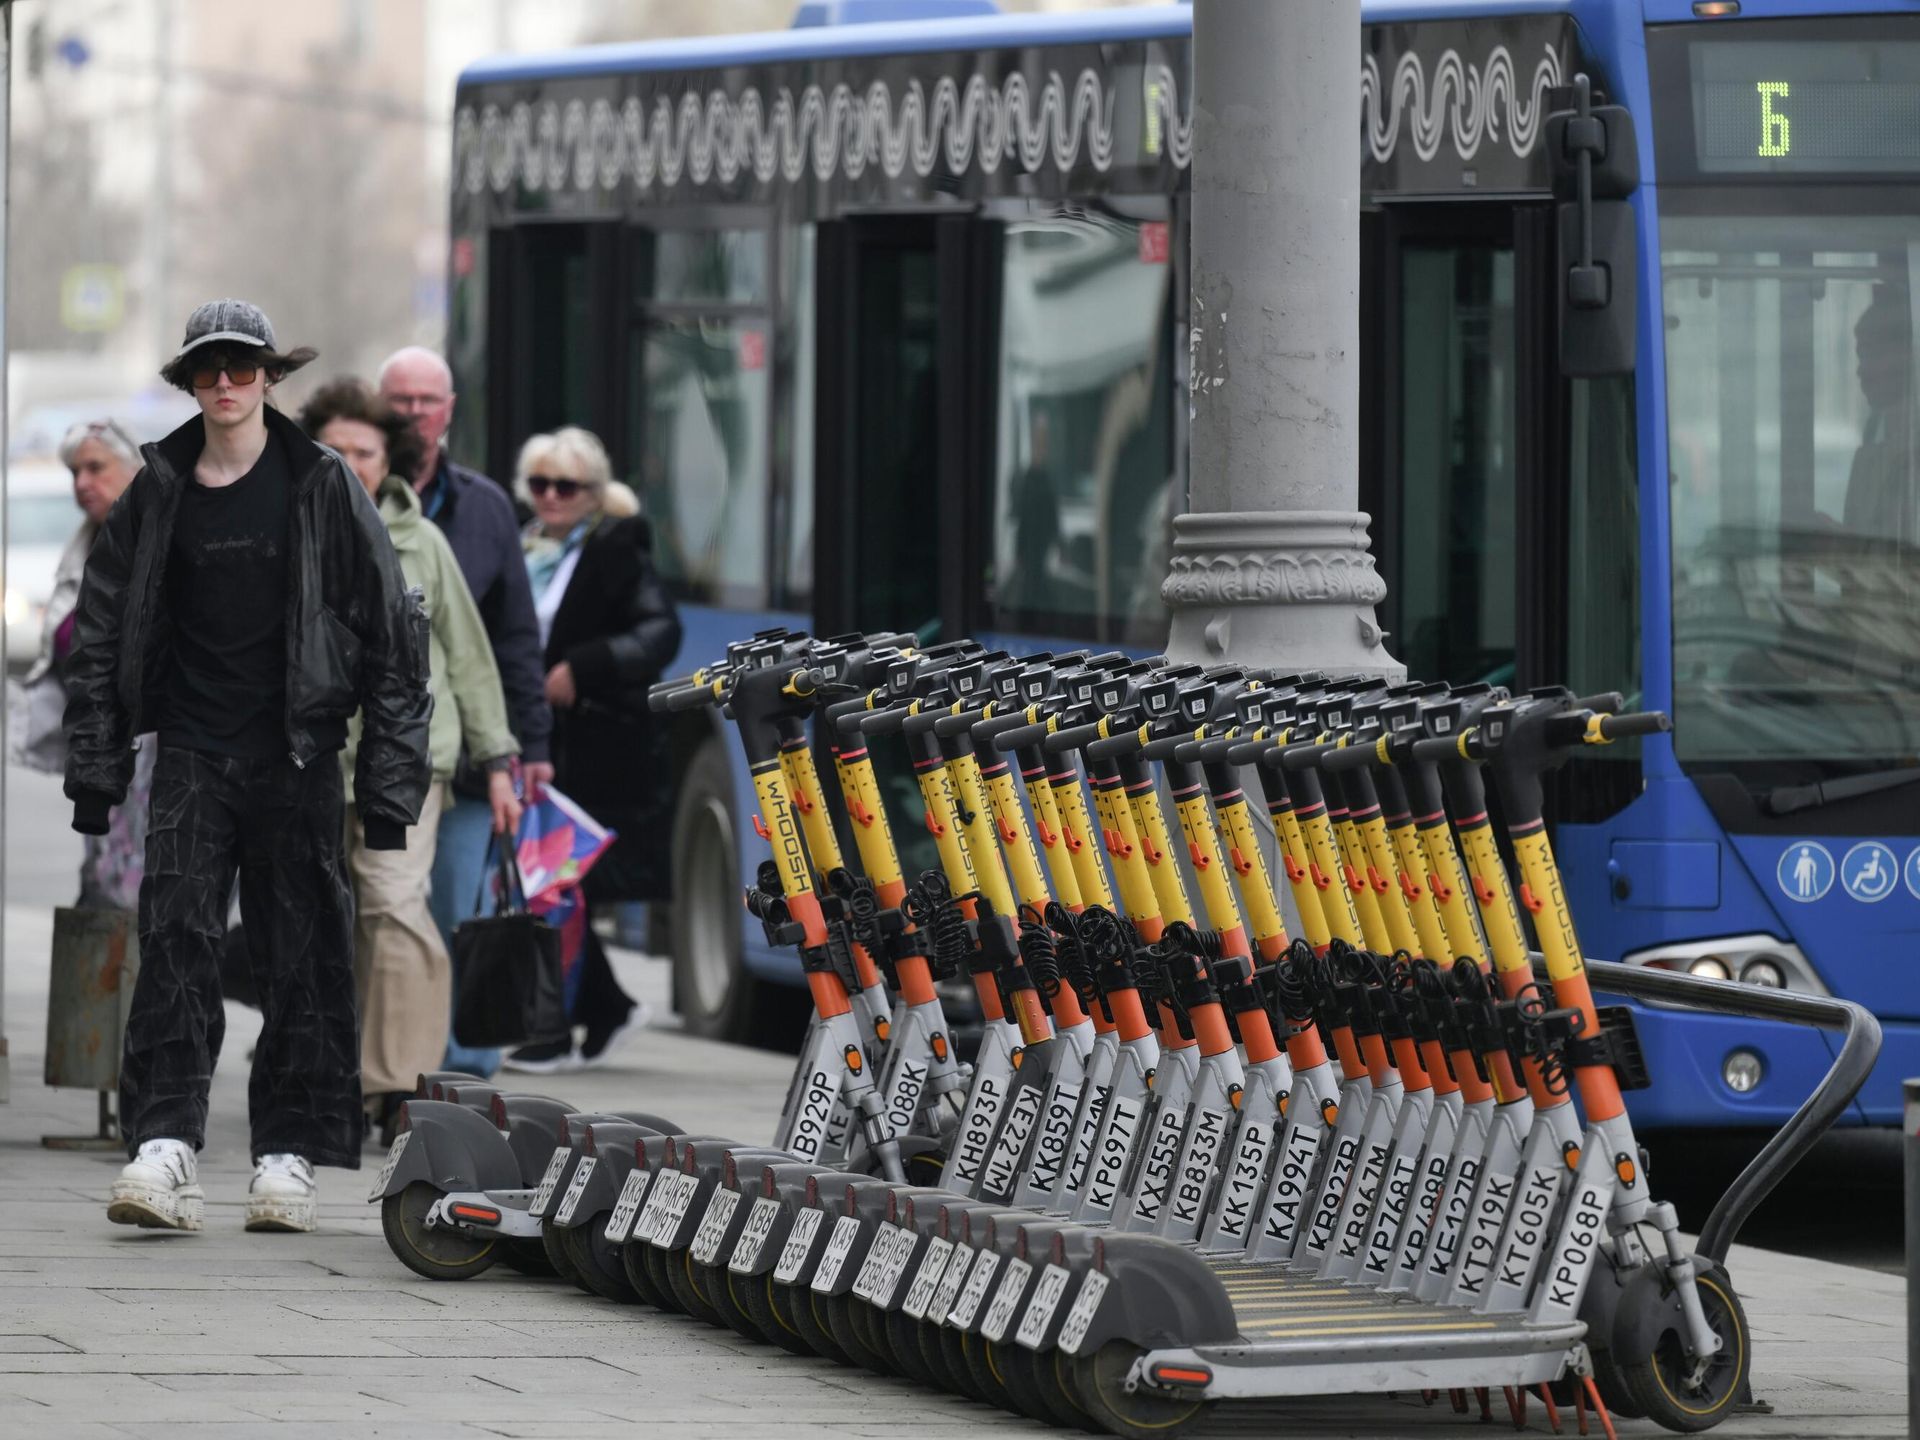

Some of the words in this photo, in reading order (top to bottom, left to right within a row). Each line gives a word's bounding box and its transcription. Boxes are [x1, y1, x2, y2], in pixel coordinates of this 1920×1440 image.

[1757, 82, 1789, 156] Б
[767, 781, 810, 892] WHOOSH
[1539, 843, 1582, 971] WHOOSH
[793, 1072, 834, 1162] B929P
[956, 1079, 1001, 1181] KH893P
[985, 1089, 1043, 1194] KE221M
[1029, 1084, 1078, 1192] KK859T
[1089, 1103, 1136, 1207] KP697T
[1136, 1112, 1182, 1220] KX555P
[1174, 1111, 1223, 1222] KB833M
[1220, 1126, 1266, 1235] KK135P
[1265, 1126, 1317, 1241] KA994T
[620, 1175, 646, 1203] KK8
[649, 1174, 676, 1202] KT4
[667, 1179, 695, 1211] KP6
[608, 1205, 634, 1233] 59T
[653, 1211, 681, 1243] 97T
[744, 1202, 777, 1235] KB8
[790, 1208, 820, 1241] KK1
[1365, 1158, 1414, 1273] KP768T
[1500, 1170, 1557, 1287] KT605K
[730, 1234, 764, 1267] 33M
[828, 1219, 858, 1251] KA9
[870, 1226, 896, 1261] KB9
[889, 1234, 915, 1268] KB9
[1459, 1177, 1512, 1293] KT919K
[1549, 1190, 1603, 1306] KP068P
[777, 1241, 807, 1273] 35P
[814, 1254, 842, 1286] 94T
[856, 1258, 882, 1294] 23B
[920, 1241, 950, 1279] KP7
[875, 1266, 901, 1301] 67M
[905, 1275, 934, 1313] 68T
[929, 1281, 956, 1319] 88P
